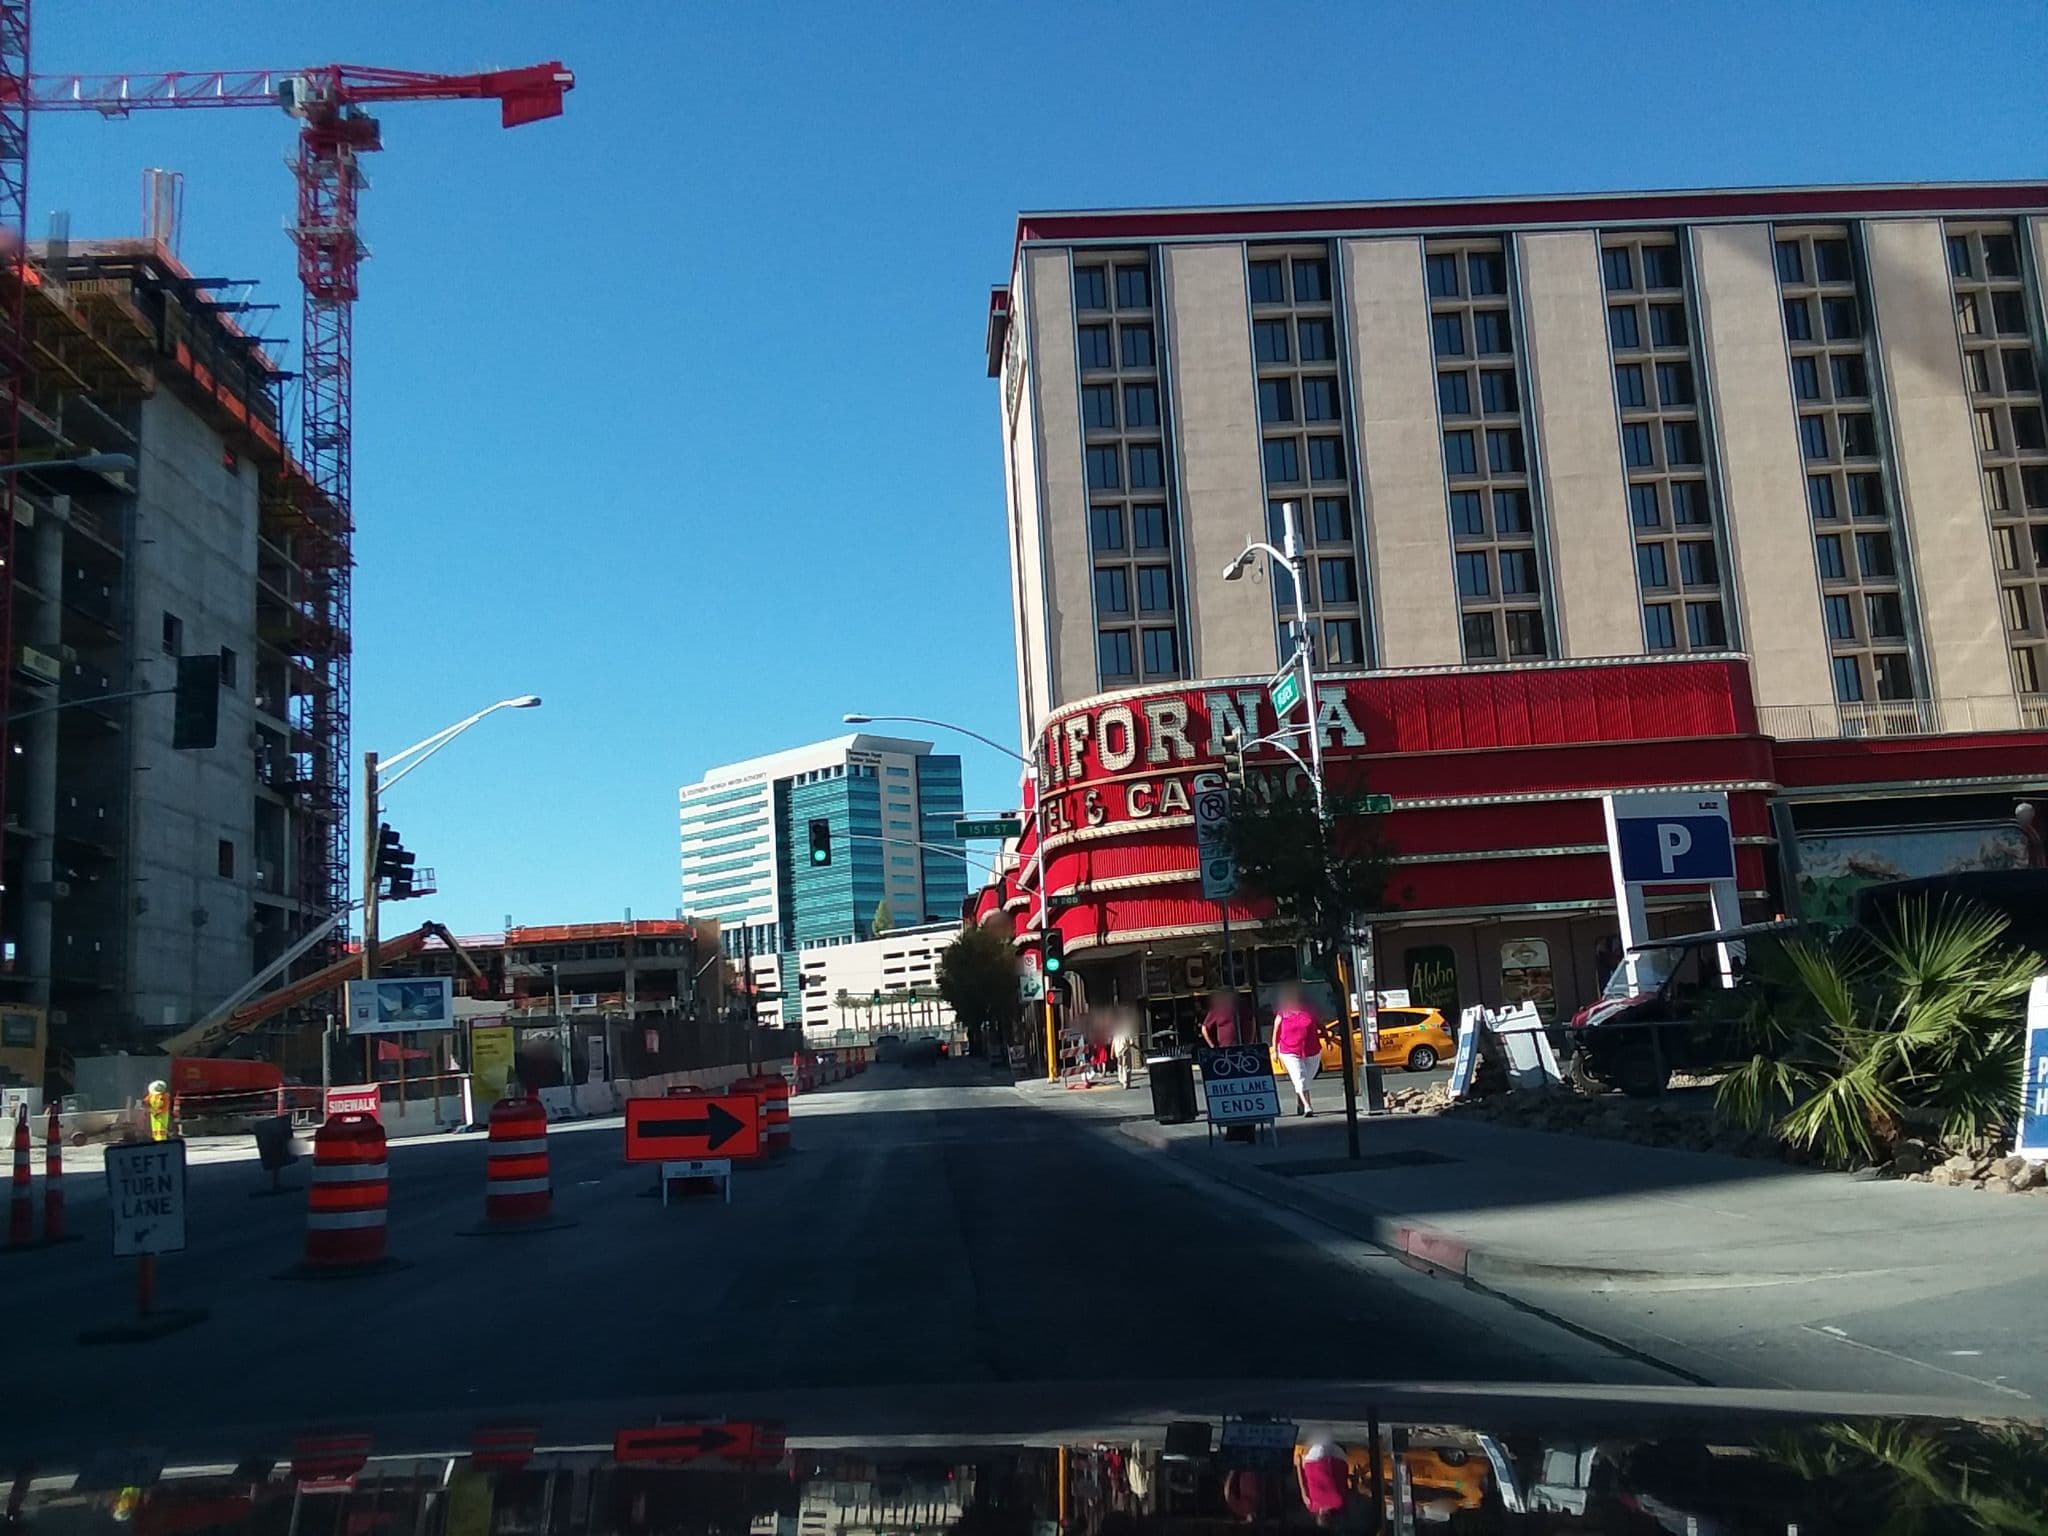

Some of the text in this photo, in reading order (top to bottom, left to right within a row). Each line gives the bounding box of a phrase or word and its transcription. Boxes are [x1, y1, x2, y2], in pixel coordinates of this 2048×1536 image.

[969, 824, 1008, 834] 1ST ST
[1657, 823, 1692, 874] P
[1212, 1081, 1268, 1095] BIKE LANE
[328, 1097, 377, 1114] SIDEWALK
[1221, 1098, 1265, 1113] ENDS
[119, 1153, 169, 1176] LEFT
[120, 1175, 172, 1196] TURN
[122, 1196, 172, 1218] LANE
